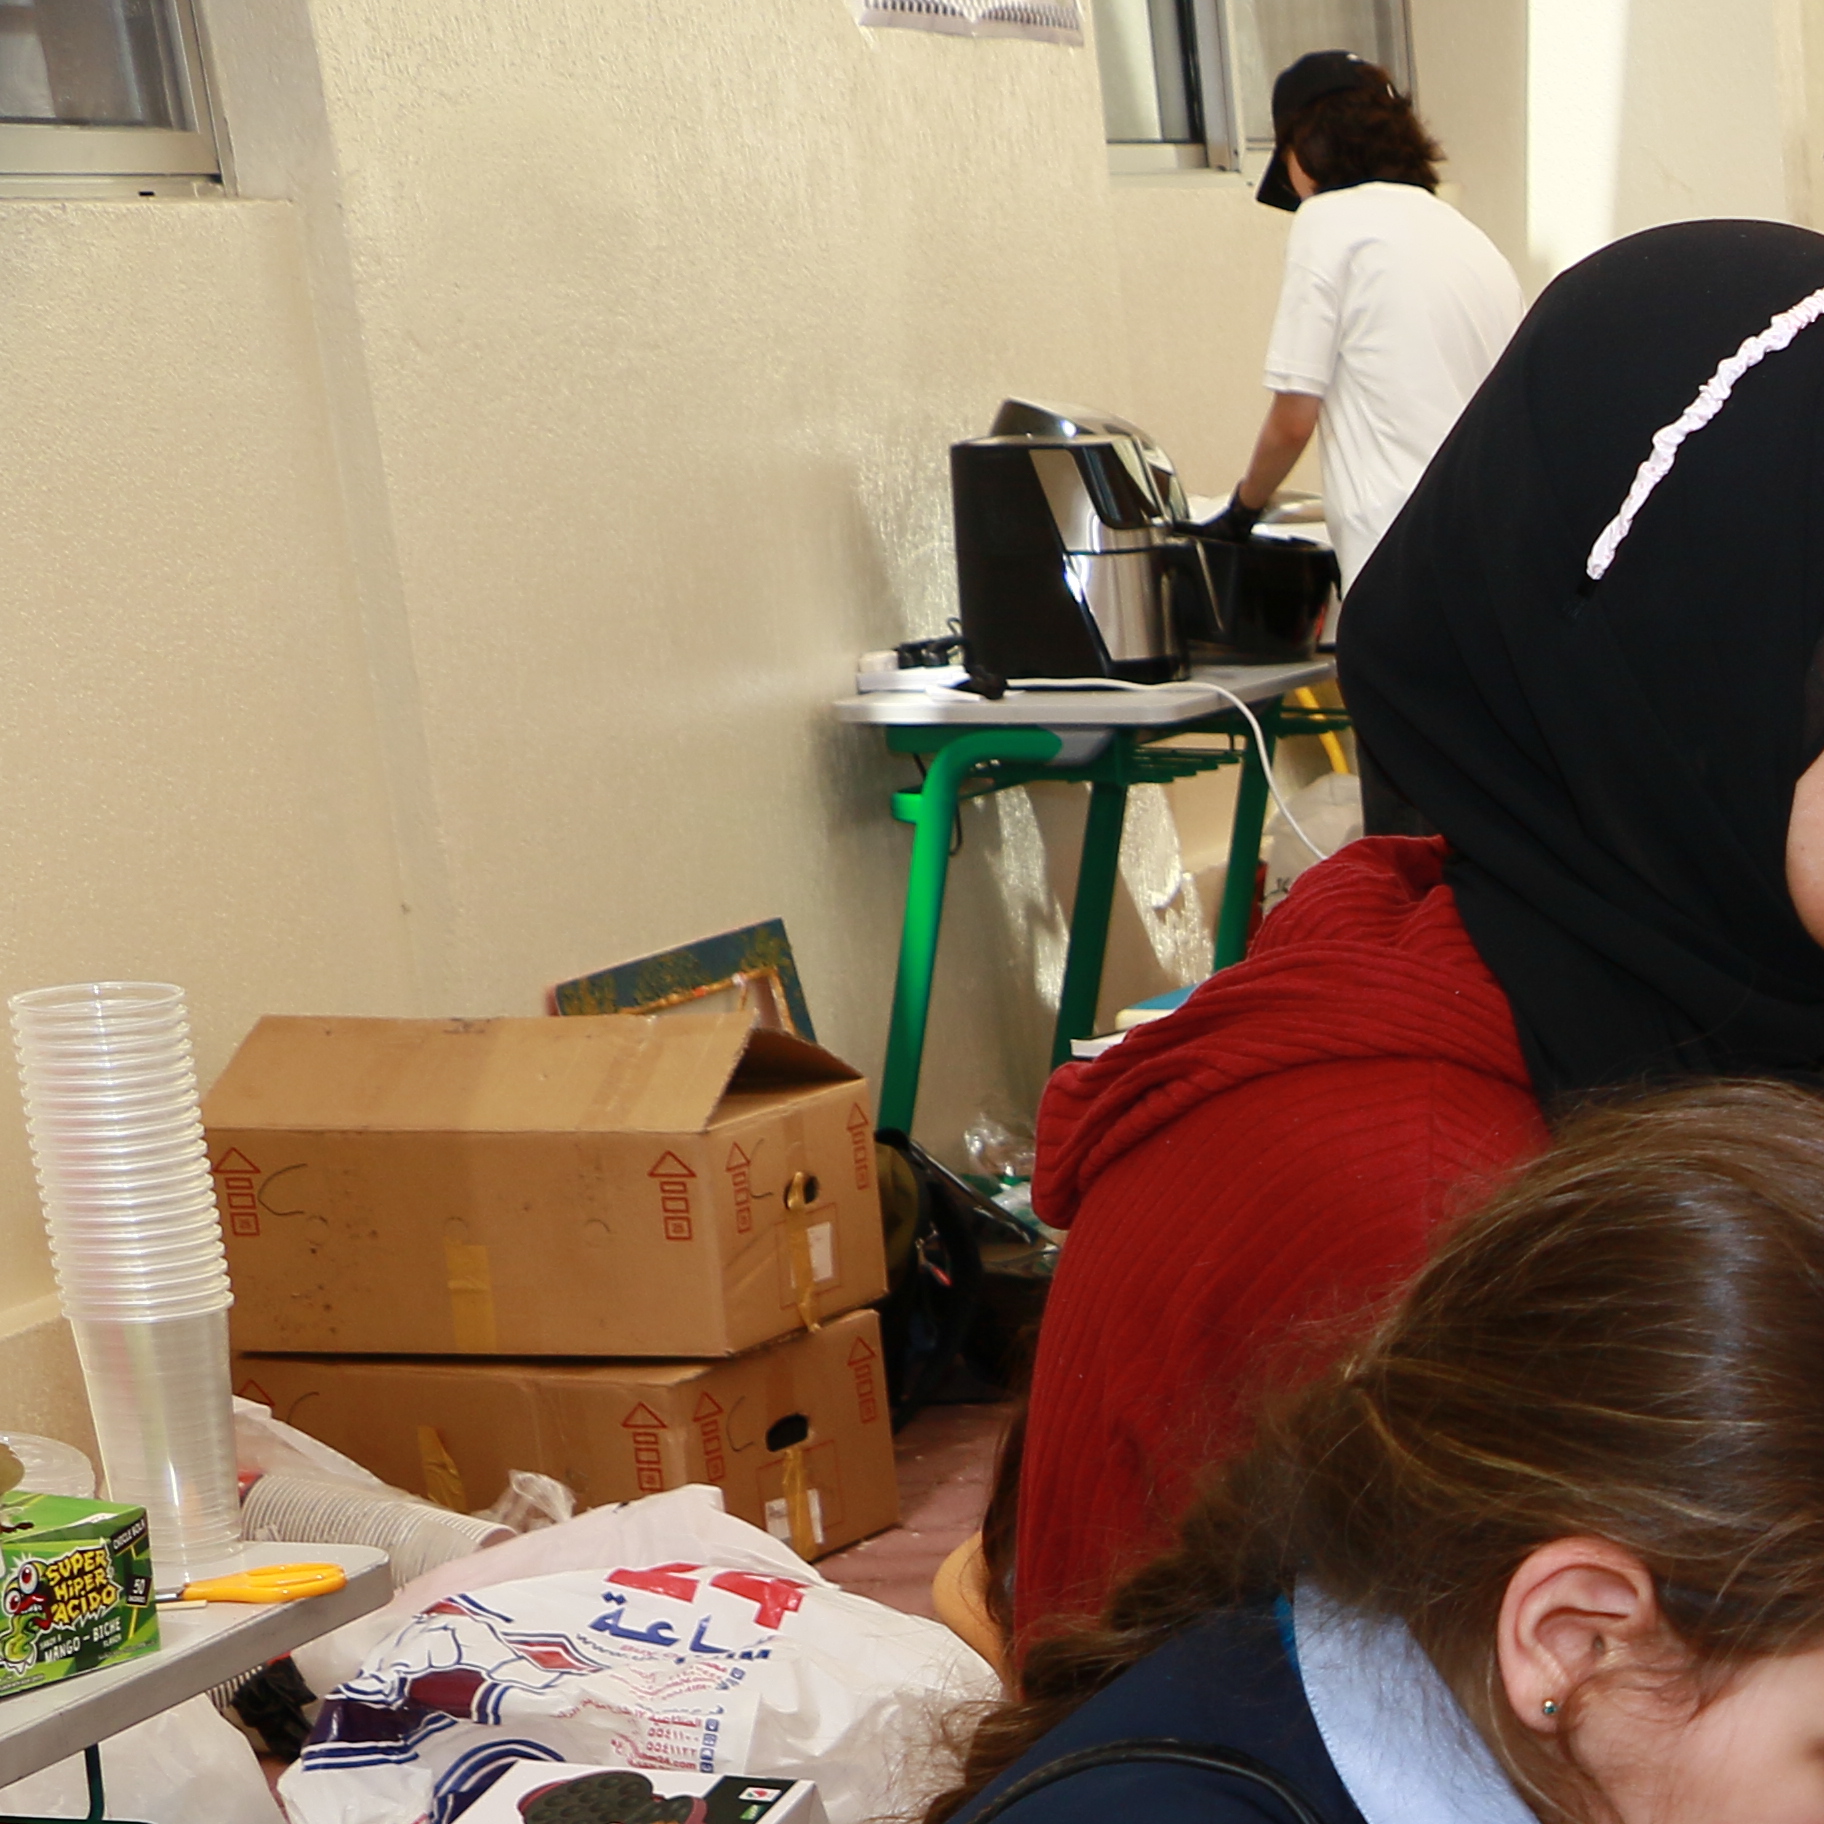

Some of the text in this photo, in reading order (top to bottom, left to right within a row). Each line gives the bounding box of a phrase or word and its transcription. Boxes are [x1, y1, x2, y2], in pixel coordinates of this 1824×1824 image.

[45, 1549, 109, 1585] SUPER
[132, 1578, 146, 1596] 50
[44, 1637, 82, 1663] MANGO
[92, 1616, 122, 1642] BICHE
